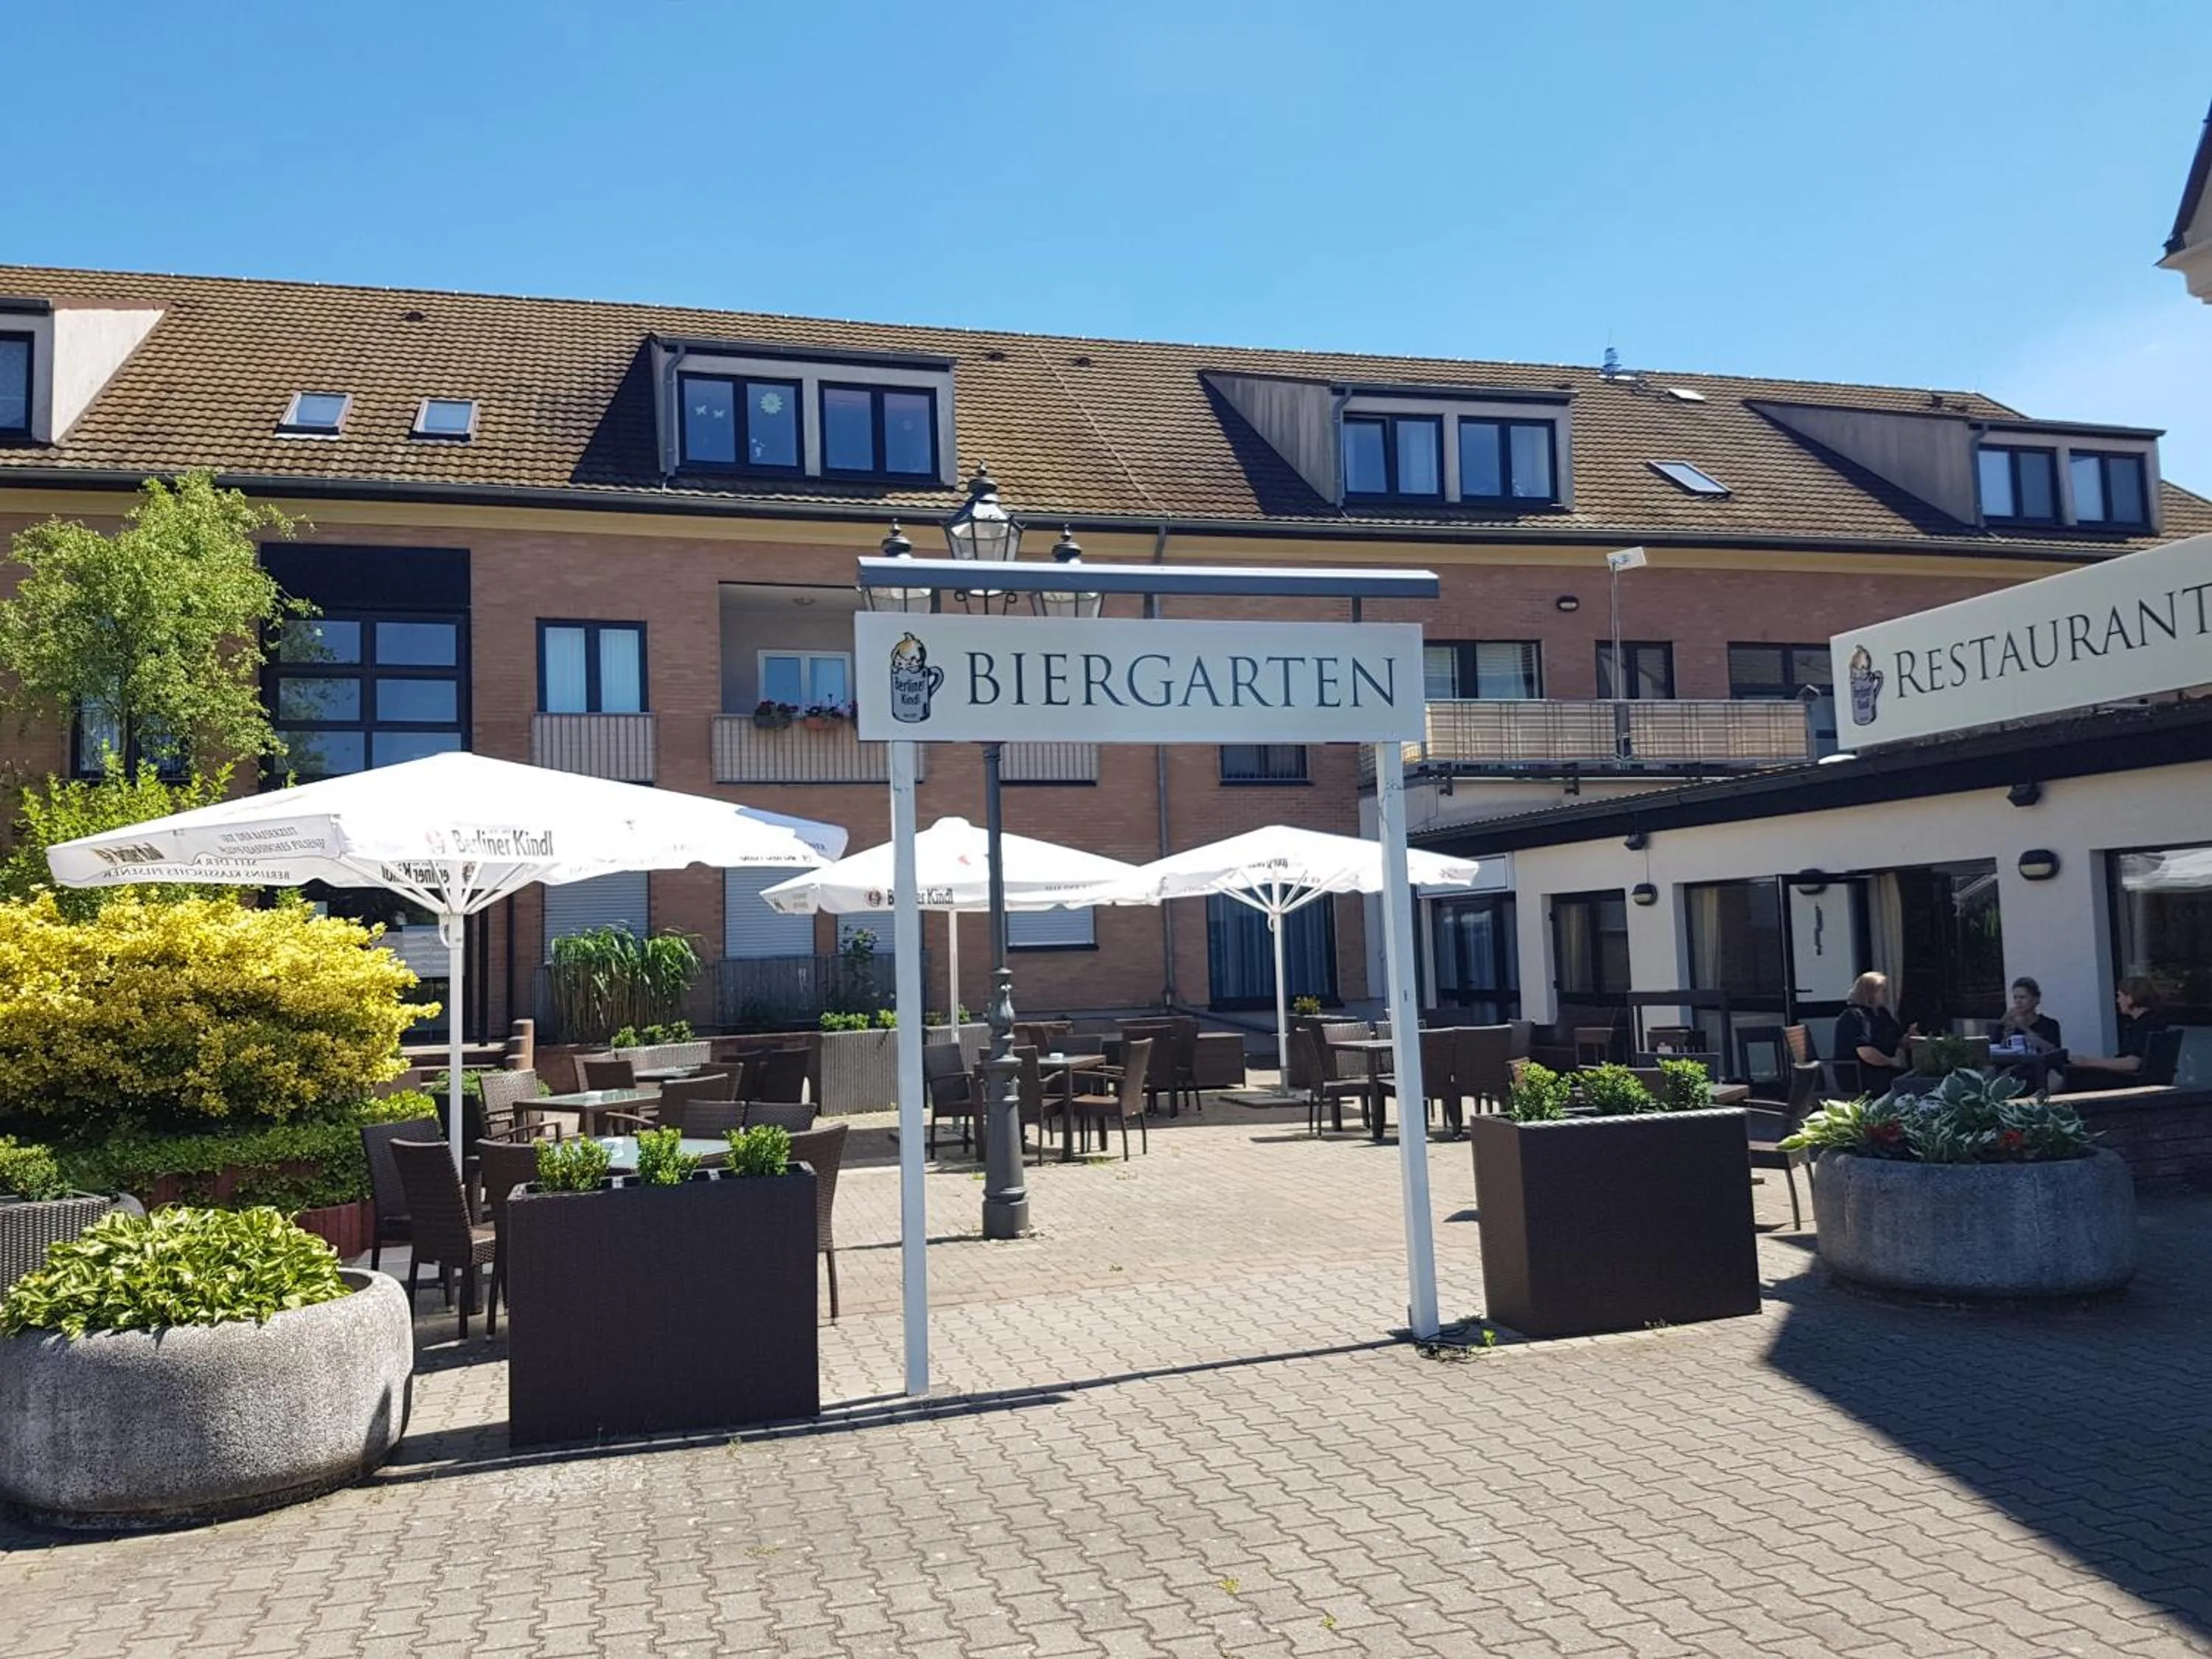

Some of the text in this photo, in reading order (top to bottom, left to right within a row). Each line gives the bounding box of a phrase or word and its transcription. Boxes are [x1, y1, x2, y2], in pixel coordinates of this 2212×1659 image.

[1893, 581, 2212, 699] RESTAURANT
[964, 650, 1397, 709] BIERGARTEN
[512, 829, 554, 856] Kindl
